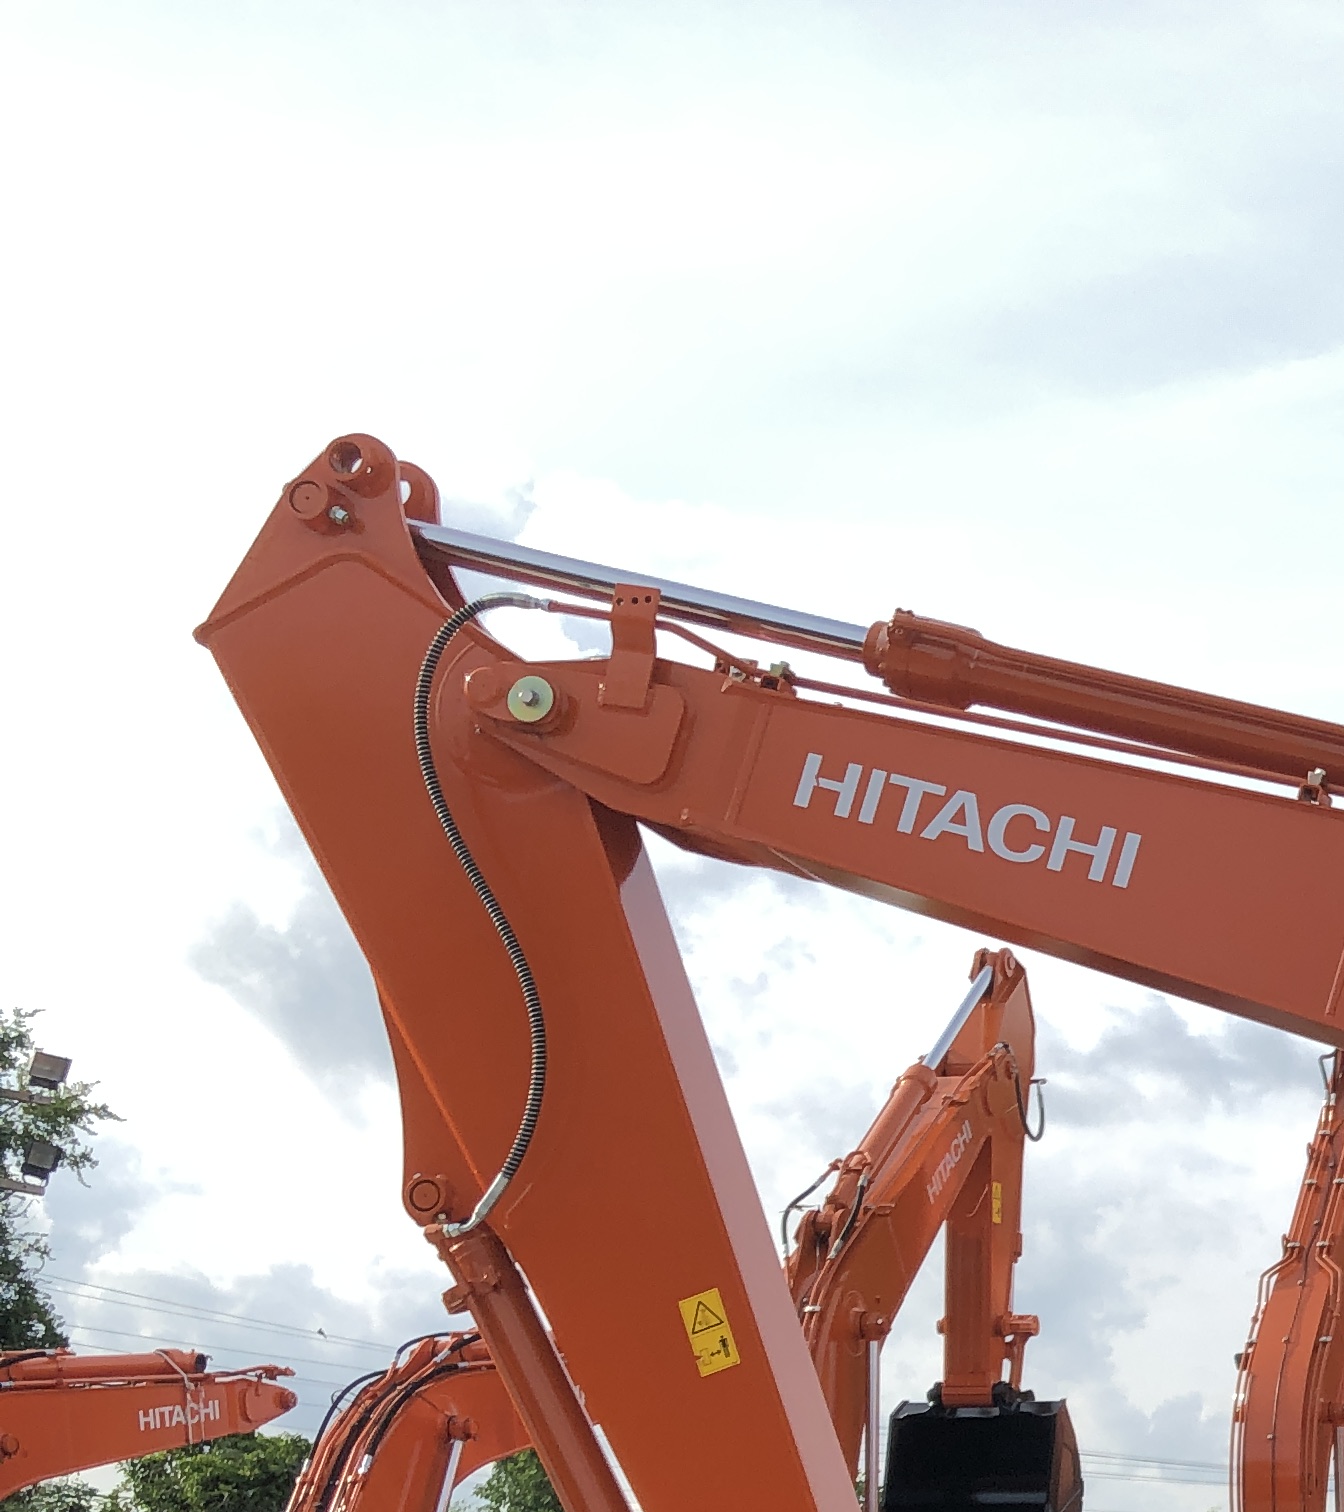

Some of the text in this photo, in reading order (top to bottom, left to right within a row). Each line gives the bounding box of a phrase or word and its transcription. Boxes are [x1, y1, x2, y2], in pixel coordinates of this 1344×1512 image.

[793, 752, 1142, 889] HITACHI
[926, 1119, 973, 1205] HITACHI
[138, 1399, 220, 1431] HITACHI
